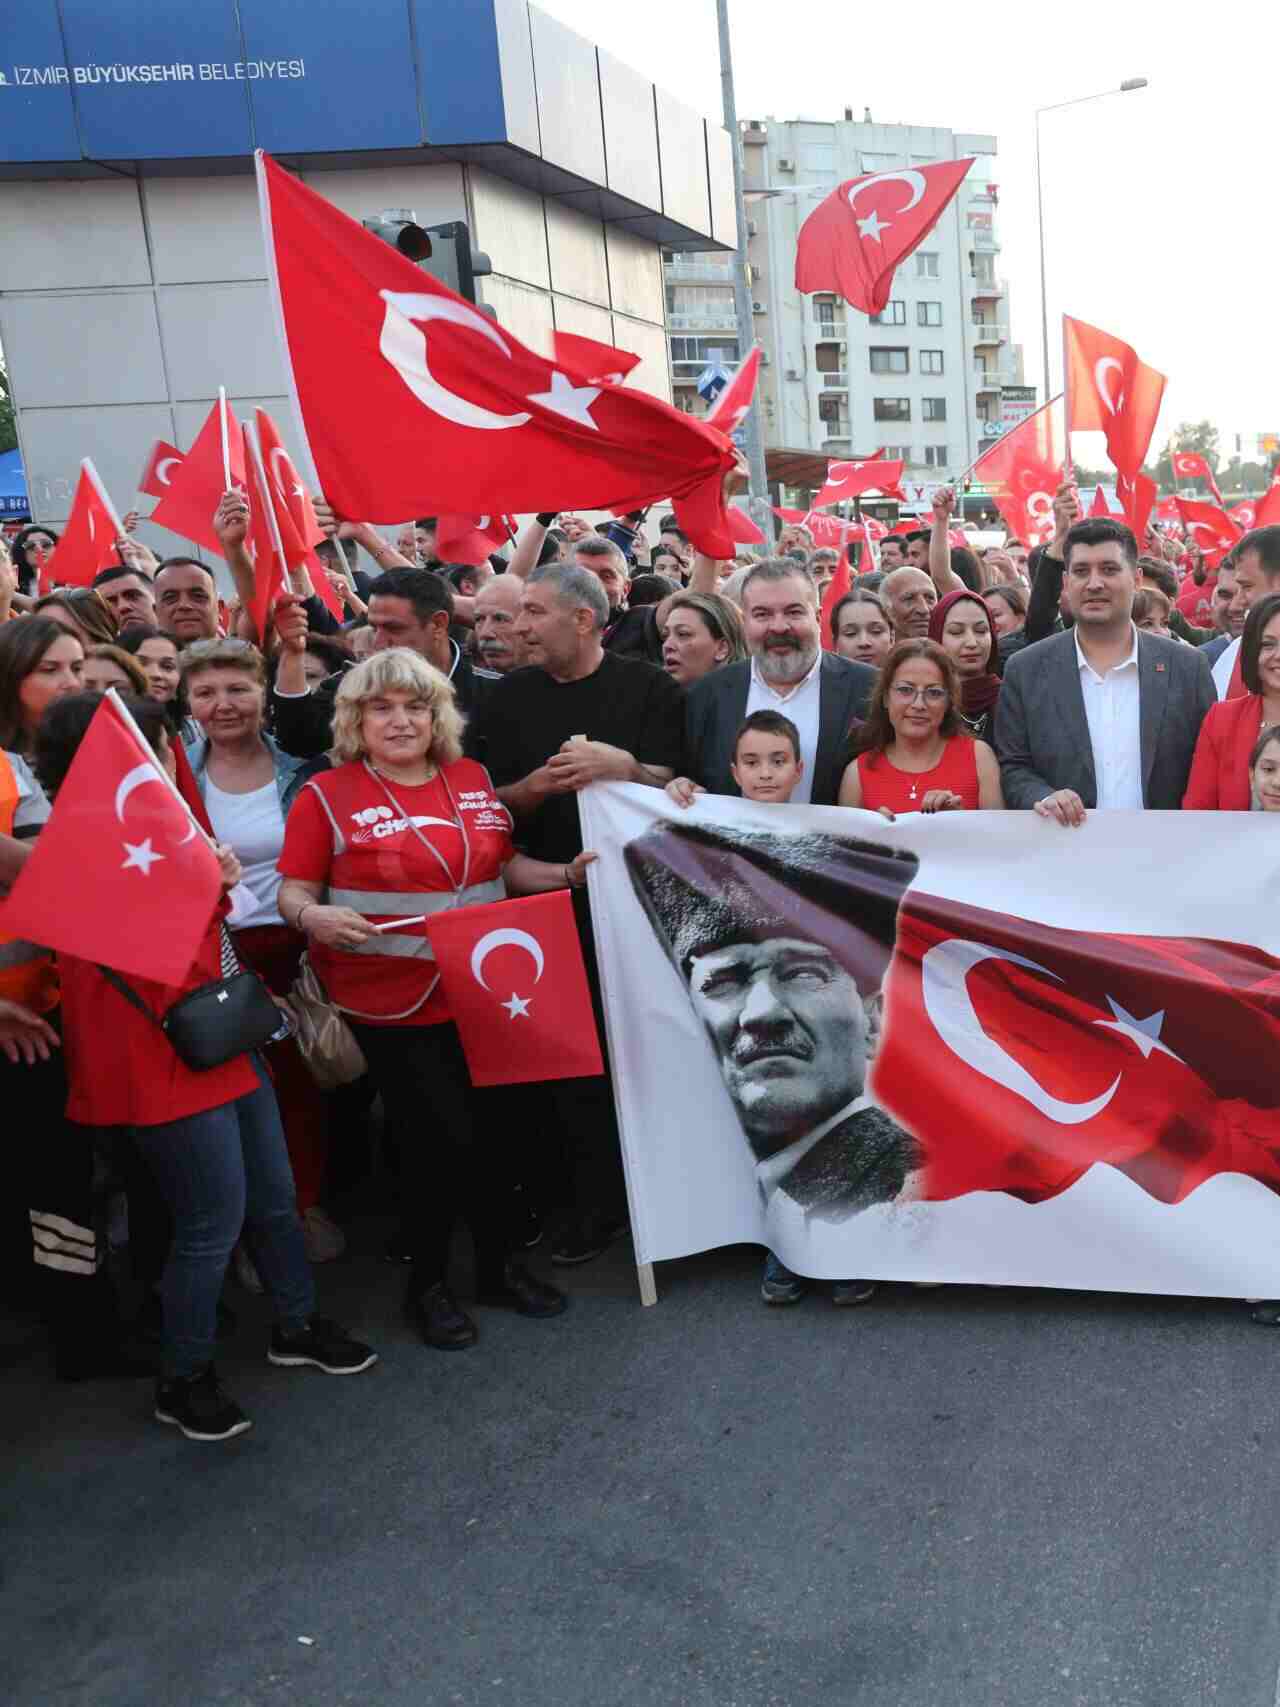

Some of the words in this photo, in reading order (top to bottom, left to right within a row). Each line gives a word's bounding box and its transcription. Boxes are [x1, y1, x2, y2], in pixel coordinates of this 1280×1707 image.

[15, 65, 69, 85] İZMİR
[73, 62, 194, 84] BÜYÜKŞEHİR
[199, 58, 305, 81] BELEDİYESİ
